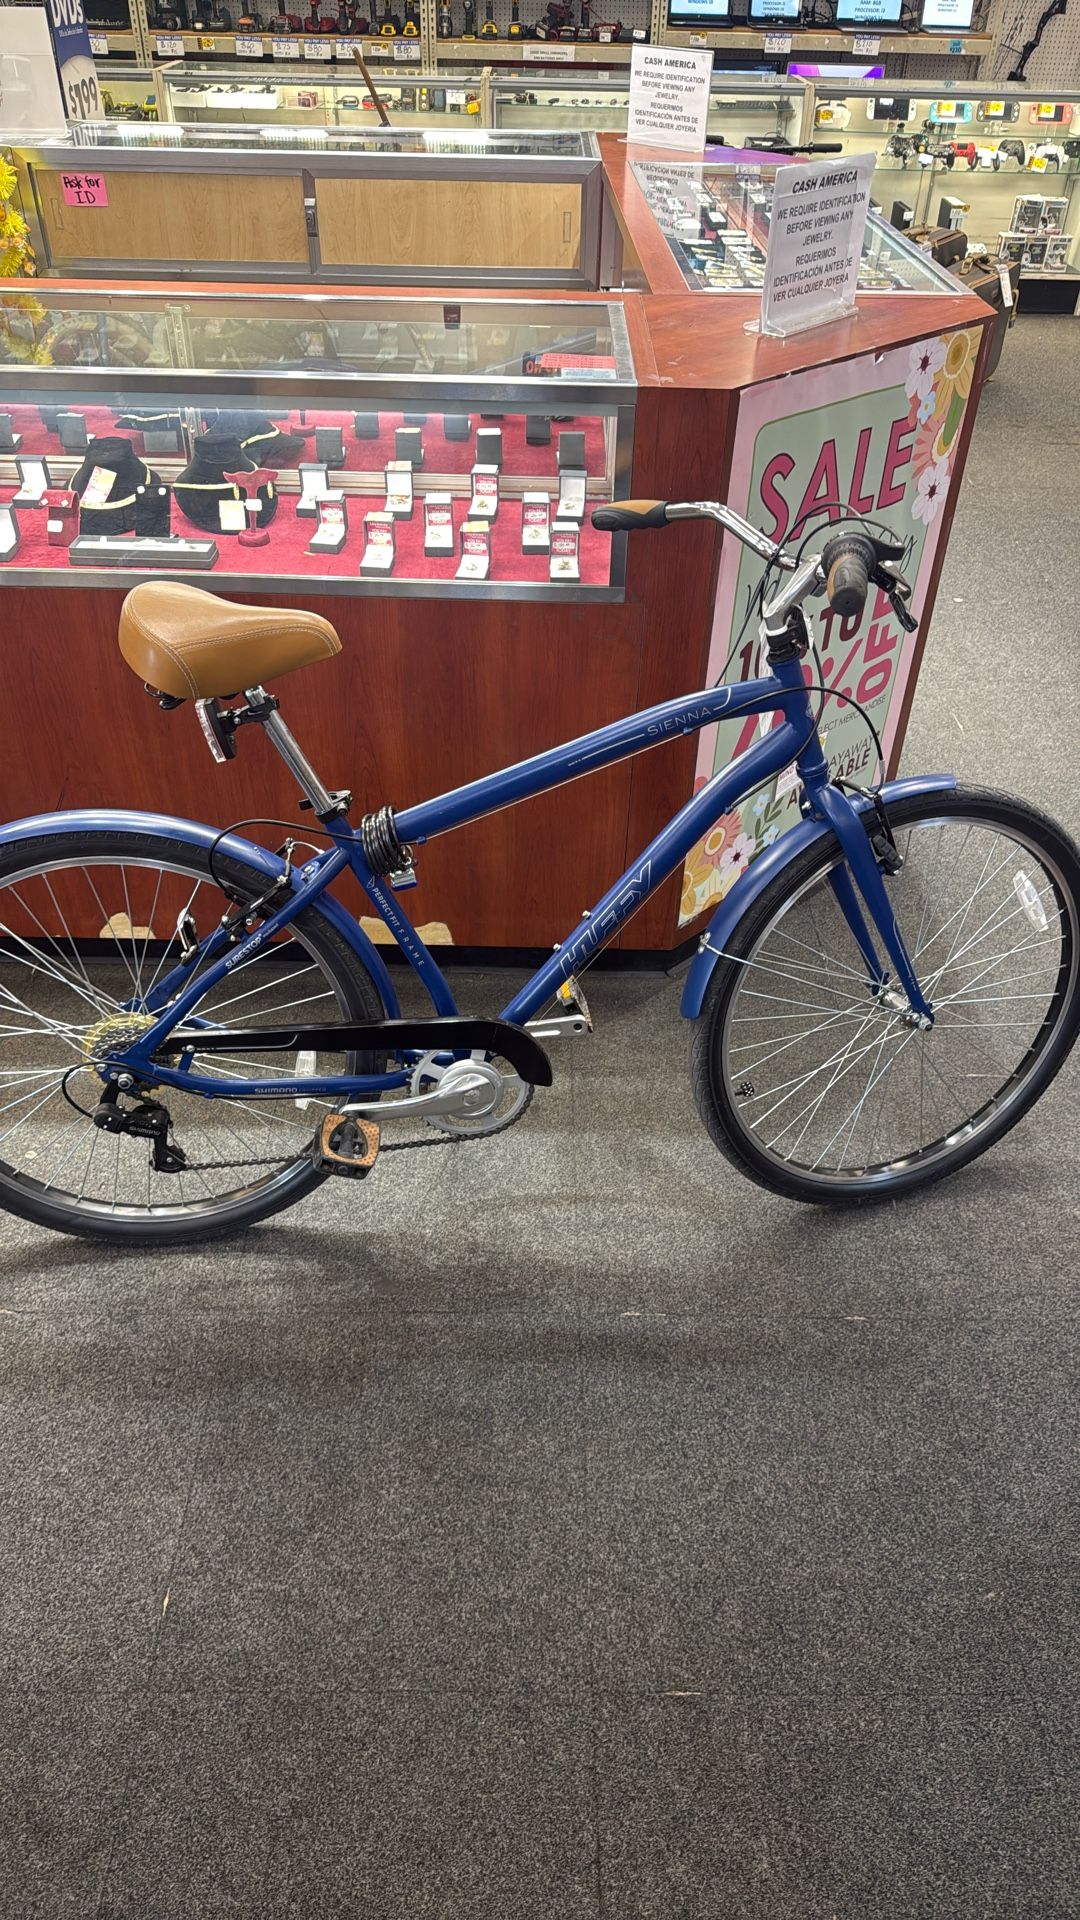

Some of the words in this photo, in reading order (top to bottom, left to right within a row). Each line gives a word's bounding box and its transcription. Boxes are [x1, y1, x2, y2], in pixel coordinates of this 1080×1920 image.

[644, 56, 663, 66] CASH
[664, 59, 697, 70] AMERICA
[641, 80, 661, 89] BEFORE
[662, 83, 684, 92] VIEWING
[643, 70, 664, 79] REQUIRE
[665, 73, 705, 84] IDENTIFICATION
[634, 109, 673, 120] IDENTIFICACIÓN
[673, 114, 691, 123] ANTES
[650, 102, 683, 112] REQUERIMOS
[635, 118, 646, 126] VER
[645, 119, 674, 130] CUALQUIER
[62, 175, 83, 190] Ask
[84, 175, 100, 189] for
[792, 178, 817, 194] CASH
[818, 170, 858, 190] AMERICA
[74, 190, 96, 204] ID
[776, 208, 788, 220] WE
[788, 202, 818, 217] REQUIRE
[818, 192, 866, 212] IDENTIFICATION
[786, 219, 813, 235] BEFORE
[813, 214, 840, 229] VIEWING
[840, 210, 854, 221] ANY
[795, 246, 837, 266] REQUERIMOS
[773, 265, 823, 288] IDENTIFICACIÓN
[823, 259, 844, 274] ANTES
[772, 290, 787, 303] VER
[786, 282, 823, 299] CUALQUIER
[759, 415, 917, 544] SALE
[647, 706, 712, 736] SIENNA
[372, 887, 394, 916] PERFECT
[389, 915, 401, 927] FIT
[398, 928, 425, 966] FRAME
